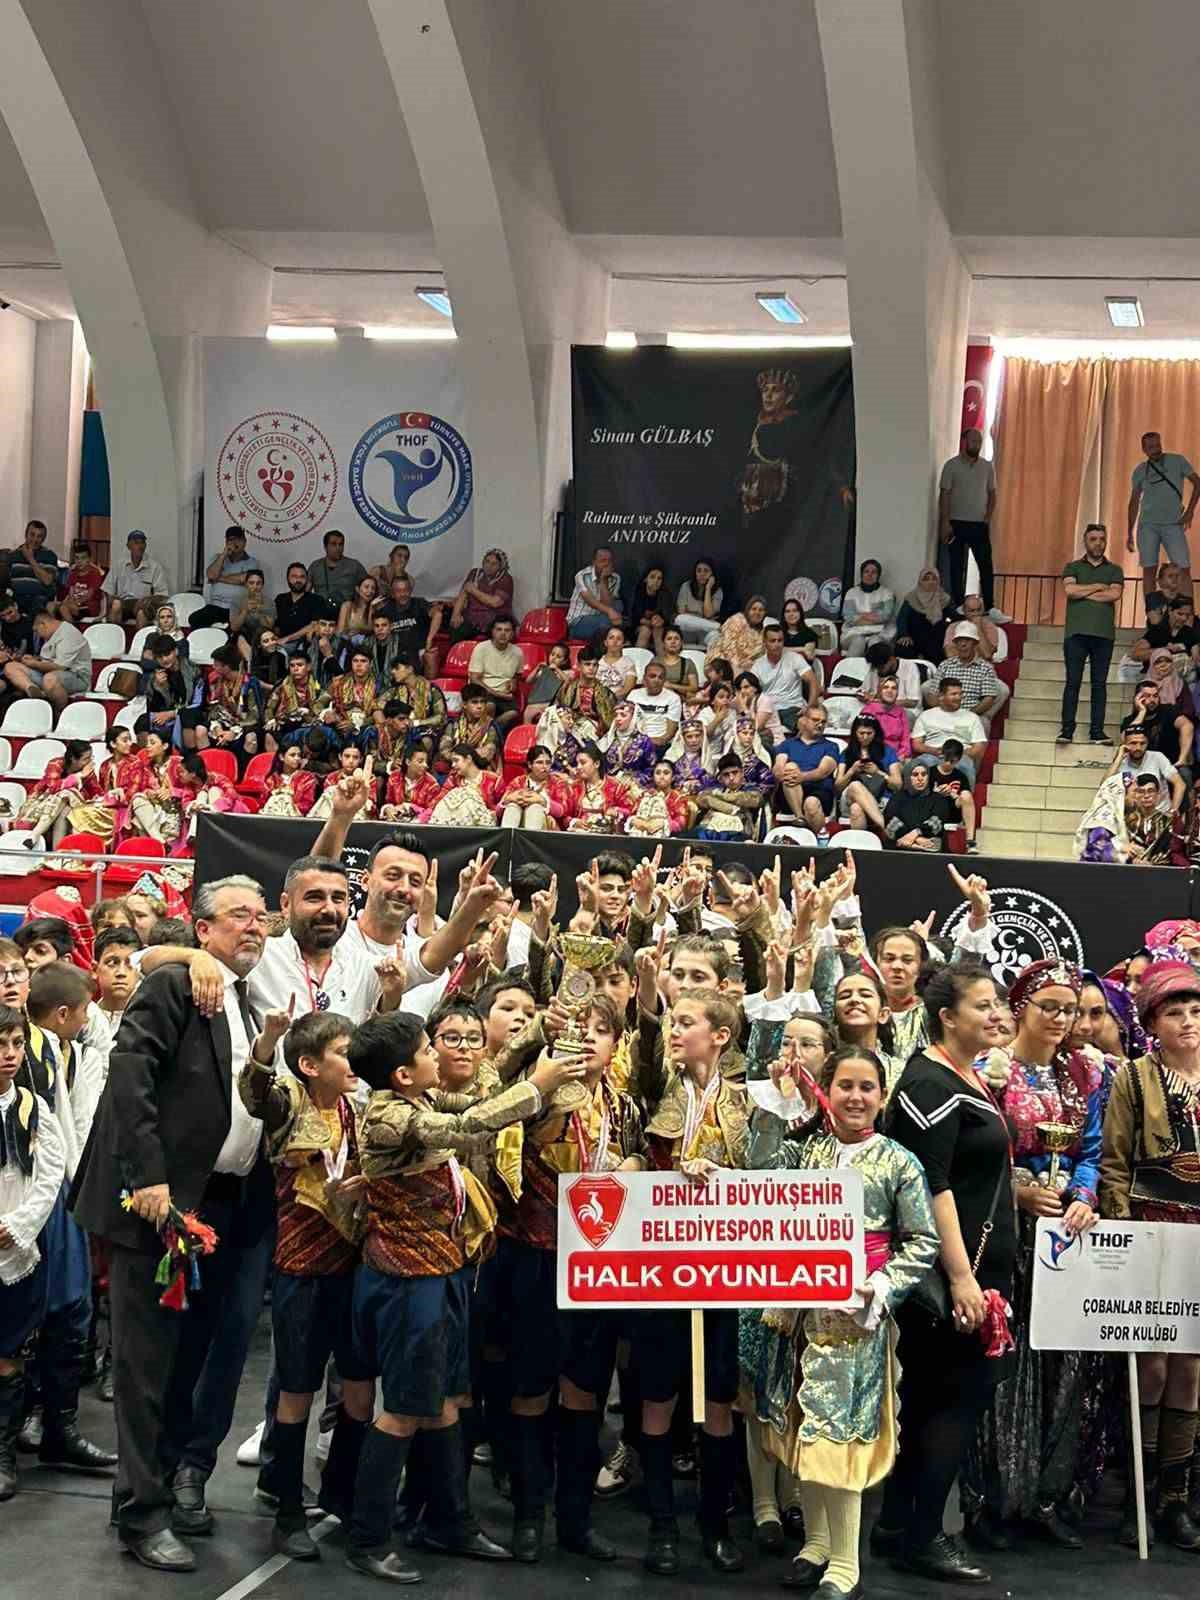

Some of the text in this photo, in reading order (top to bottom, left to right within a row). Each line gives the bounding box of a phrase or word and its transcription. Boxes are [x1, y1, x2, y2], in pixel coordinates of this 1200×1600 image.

[396, 435, 429, 446] THOF
[590, 425, 714, 447] Sinan GÜLBAŞ
[583, 511, 717, 528] Rahmet ve Şükranla
[608, 530, 692, 544] ANIYORUZ
[996, 914, 1038, 931] GENÇLİK
[1036, 927, 1049, 941] VE
[1044, 940, 1057, 960] SPO
[652, 1178, 721, 1207] DENİZLİ
[727, 1177, 843, 1211] BÜYÜKŞEHİR
[642, 1213, 854, 1242] BELEDİYESPOR KULÜBÜ
[1089, 1232, 1134, 1248] THOF
[573, 1265, 847, 1288] HALK OYUNLARI
[1083, 1298, 1200, 1317] ÇOBANLAR BELEDİYE
[1100, 1324, 1178, 1341] SPOR KULÜBÜ
